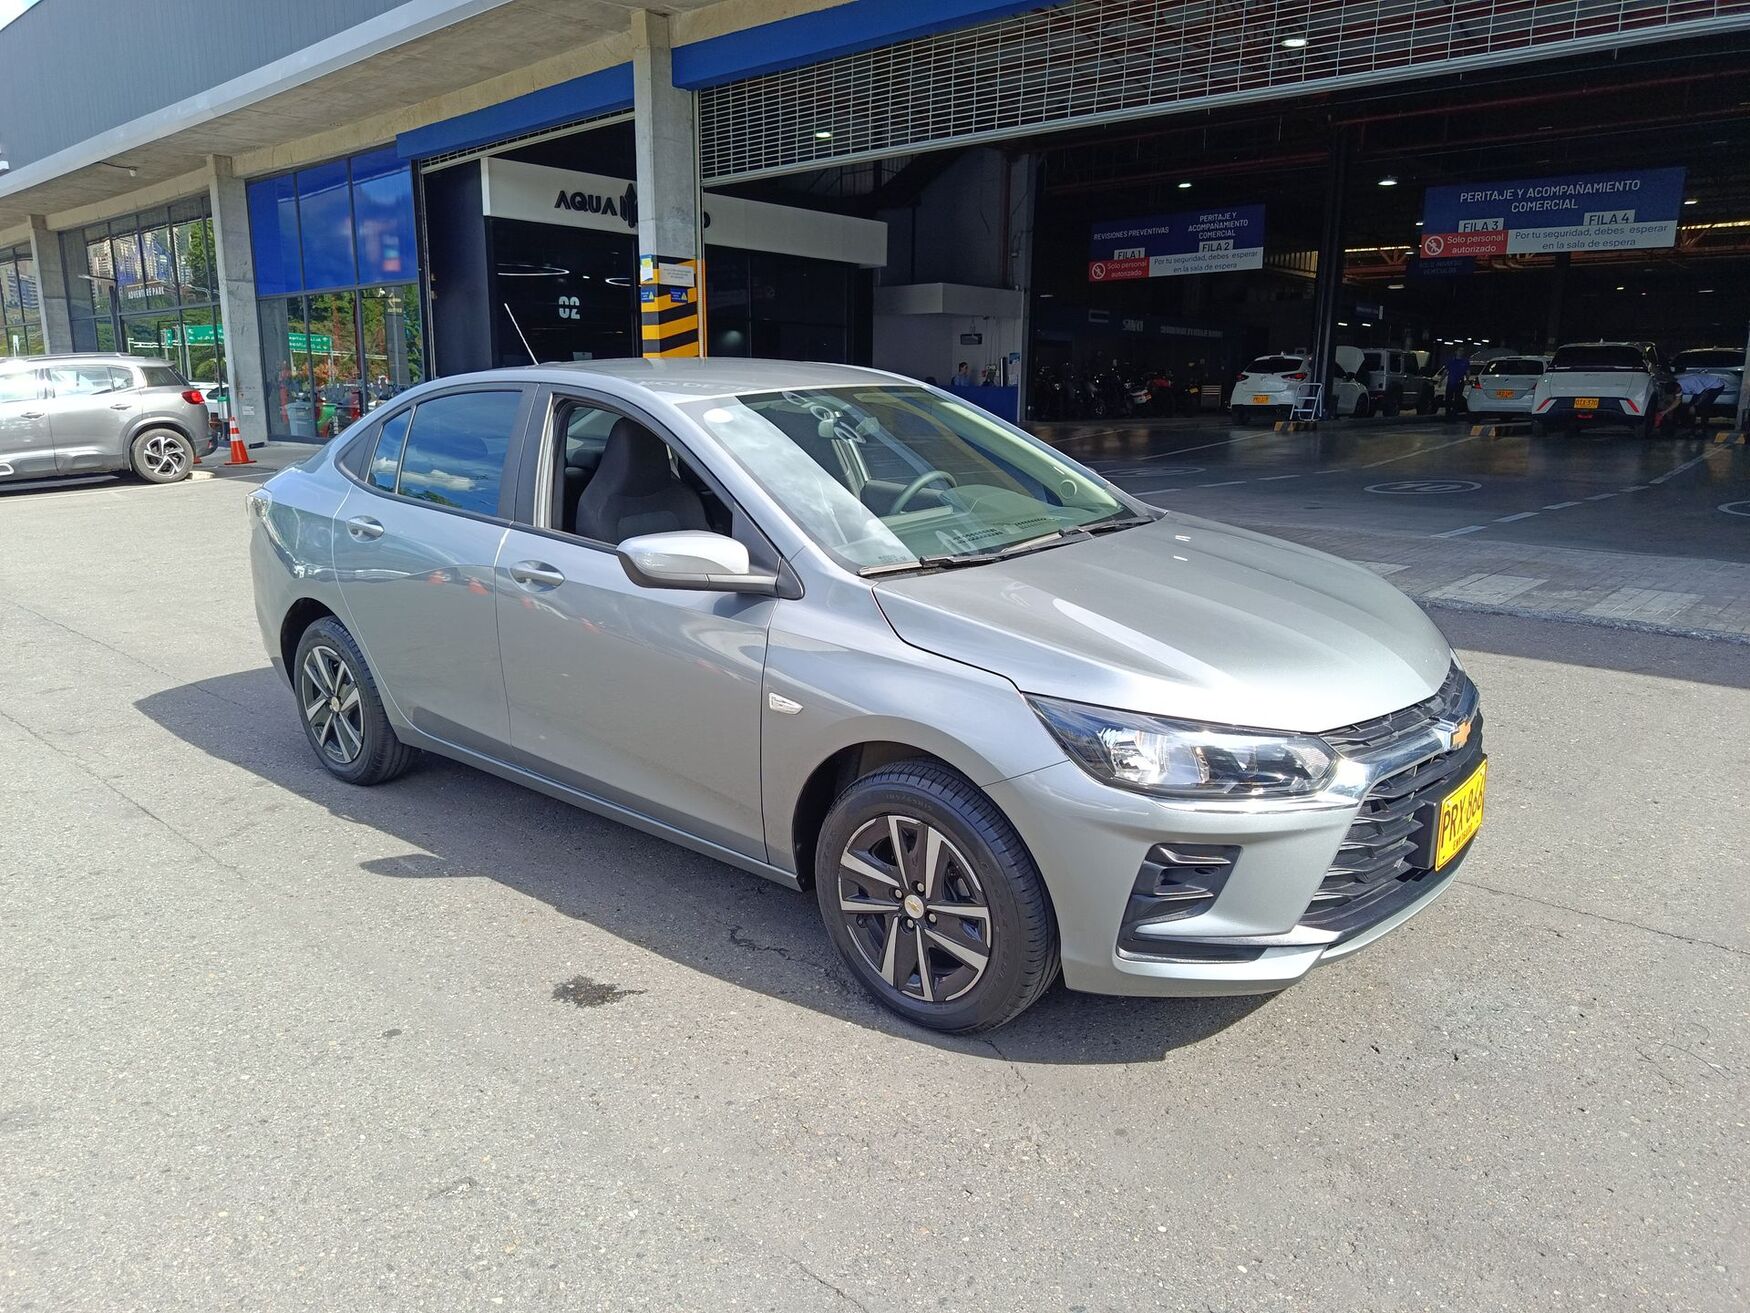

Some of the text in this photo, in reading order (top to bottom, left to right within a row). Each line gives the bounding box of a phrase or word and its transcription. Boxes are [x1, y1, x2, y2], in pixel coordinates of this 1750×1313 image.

[1460, 180, 1641, 203] PERITAJE Y ACOMPAÑAMIENTO
[554, 190, 618, 215] AQUA
[1511, 199, 1579, 213] COMERCIAL
[1200, 212, 1231, 222] PERITAJE
[1588, 213, 1630, 226] FILA 4
[1188, 219, 1249, 232] ACOMPAÑAMIENTO
[1463, 220, 1499, 232] FILA 3
[1515, 224, 1668, 240] Por tu seguridad, debes esperar
[1094, 227, 1169, 240] REVISIONES PREVENTIVAS
[1199, 229, 1236, 240] COMERCIAL
[1447, 233, 1505, 245] Solo personal
[1202, 242, 1230, 252] FILA 2
[1452, 245, 1497, 255] autorizado
[1542, 237, 1636, 250] en la sala de espera
[1117, 250, 1136, 260] FILA
[558, 296, 581, 319] 02
